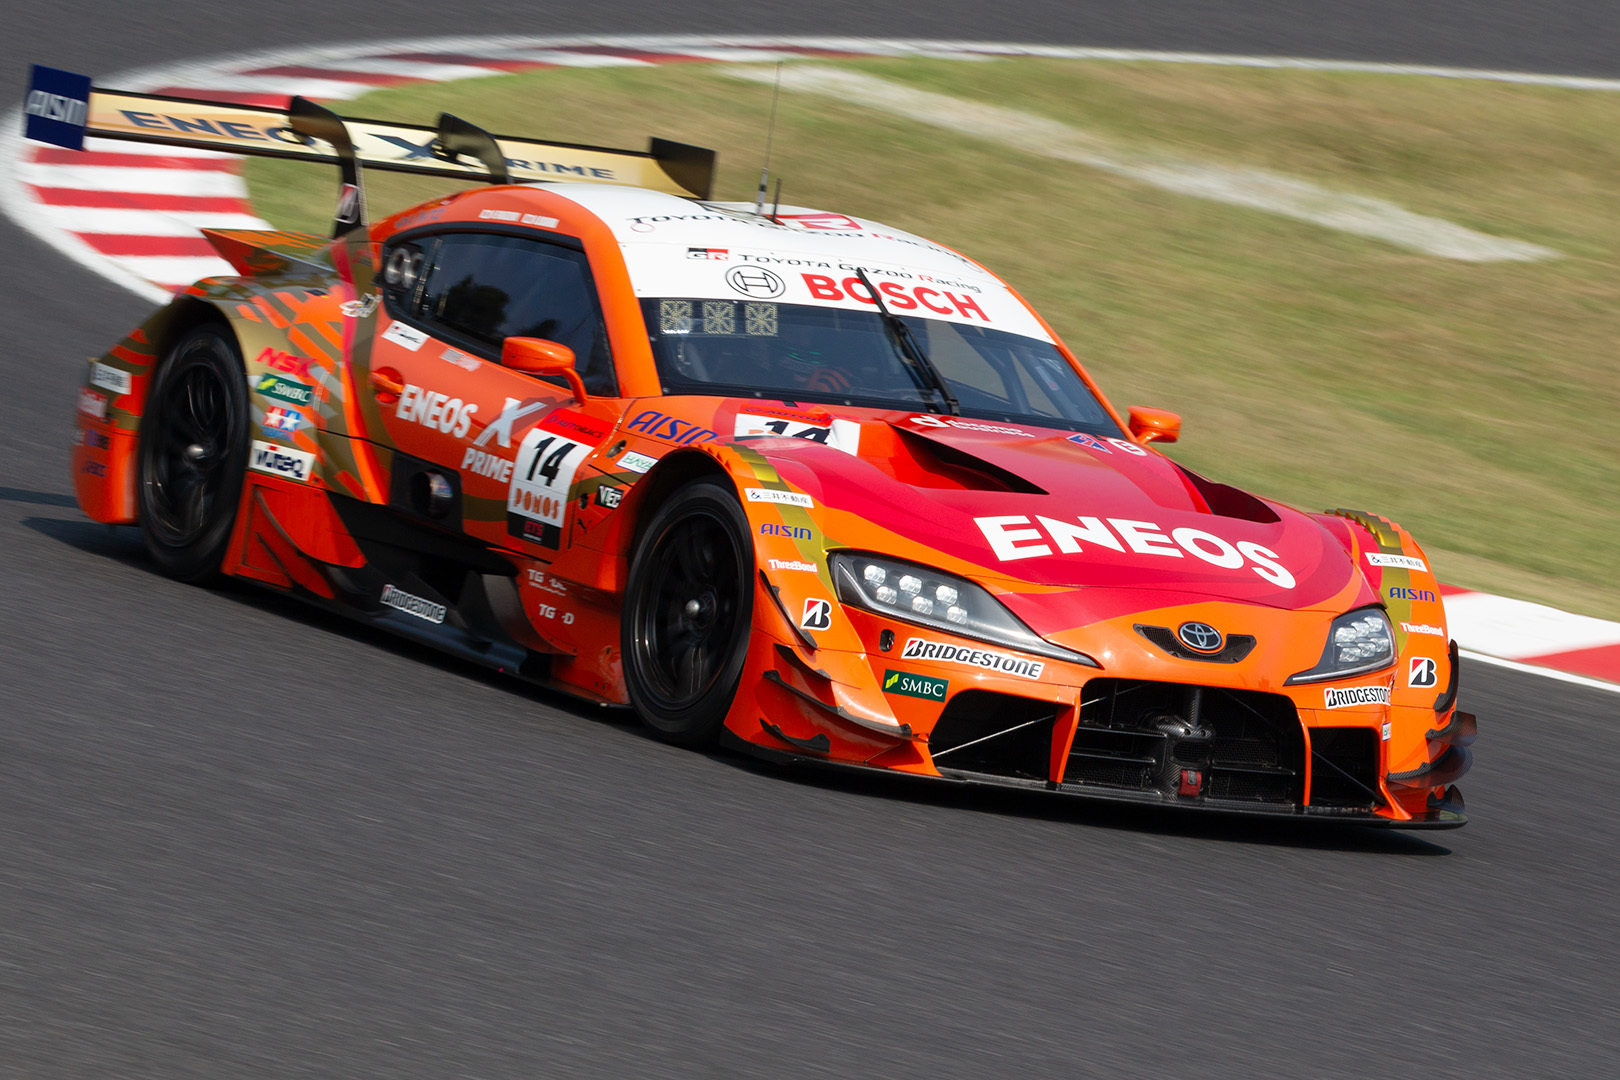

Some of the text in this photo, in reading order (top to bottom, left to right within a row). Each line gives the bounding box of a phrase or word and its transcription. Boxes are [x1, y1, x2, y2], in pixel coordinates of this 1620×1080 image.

[503, 157, 618, 181] RIME
[687, 247, 729, 260] GR
[738, 253, 831, 268] TOYOTA
[918, 274, 983, 294] Racing
[799, 273, 991, 323] BOSCH
[255, 346, 317, 378] NSK
[396, 384, 547, 448] ENEOS X
[627, 411, 719, 444] AISIN
[765, 420, 830, 445] 14
[461, 448, 514, 483] PRIME
[526, 437, 577, 487] 14
[513, 488, 559, 519] PONOS
[760, 523, 811, 540] AISIN
[768, 559, 817, 572] ThreeBond
[973, 514, 1296, 589] ENEOS
[1389, 587, 1435, 602] AISIN
[1400, 622, 1444, 636] ThreeBond
[904, 640, 1042, 678] BRIDGESTONE
[901, 678, 944, 698] SMBC
